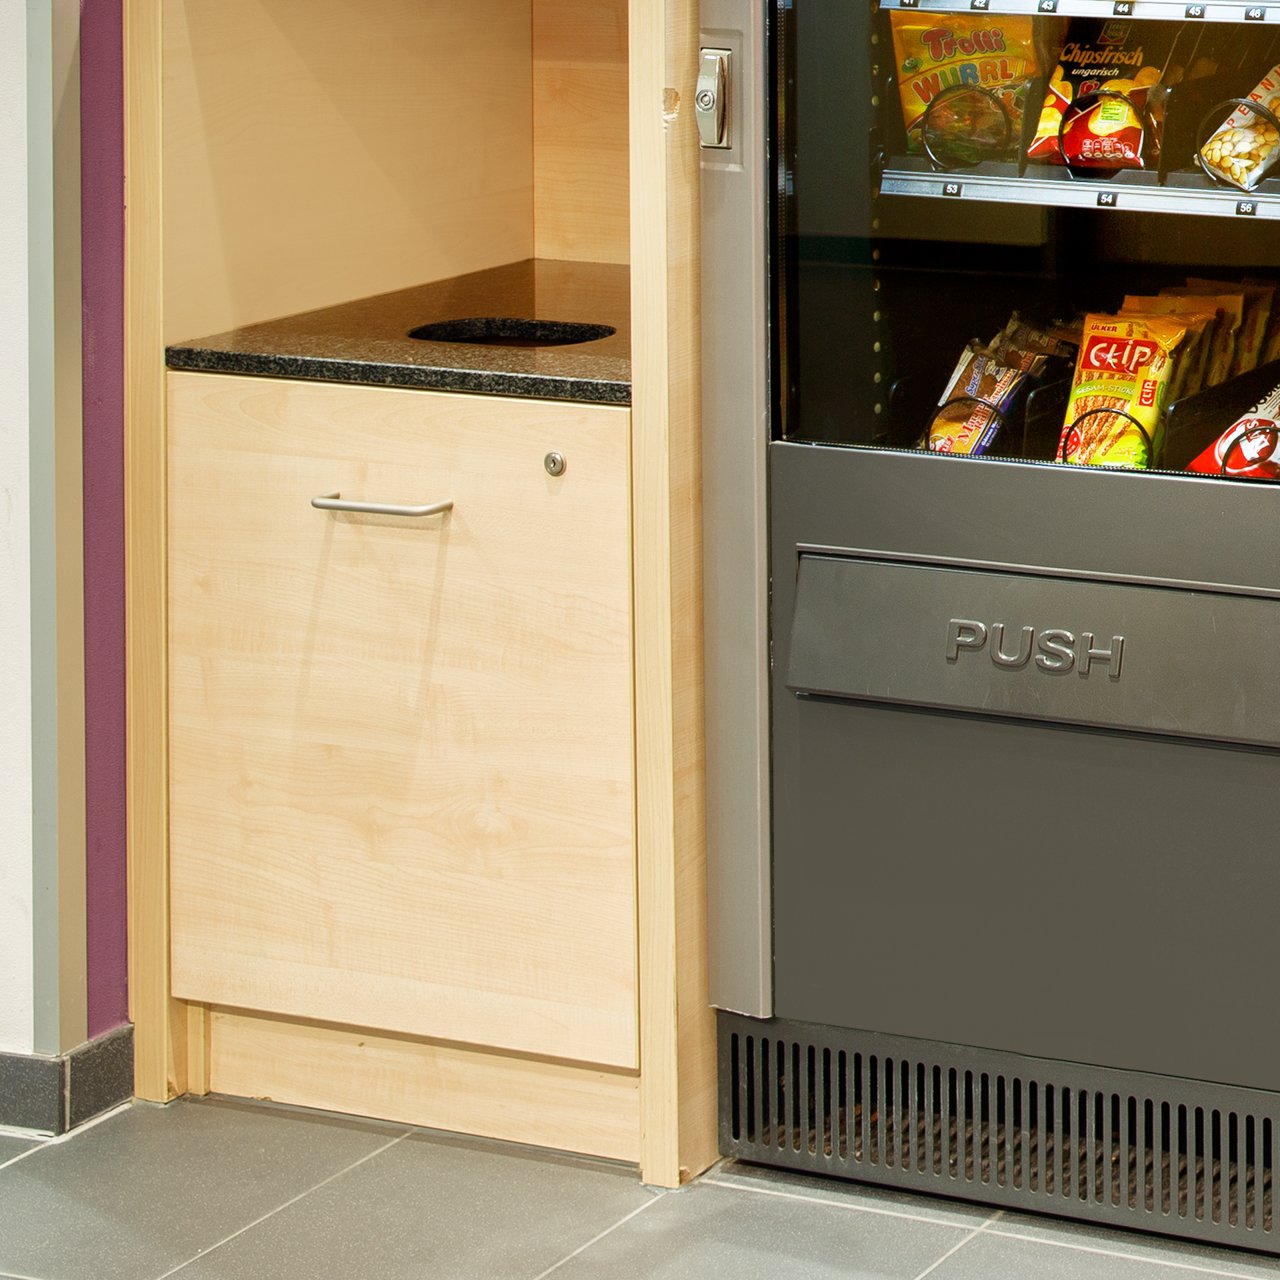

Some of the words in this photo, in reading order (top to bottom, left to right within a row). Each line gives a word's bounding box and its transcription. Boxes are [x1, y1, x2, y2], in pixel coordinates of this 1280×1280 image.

[1042, 0, 1053, 10] 43
[1116, 4, 1128, 12] 44
[1189, 6, 1201, 16] 45
[1248, 9, 1260, 18] 46
[922, 27, 1006, 62] Trolli
[1060, 42, 1144, 67] Chipsfrisch
[1072, 67, 1120, 77] ungarisch
[946, 184, 958, 194] 53
[1100, 194, 1113, 204] 54
[1240, 203, 1252, 212] 56
[1091, 323, 1118, 332] ÜLKER
[1090, 340, 1152, 371] CLIP
[1142, 380, 1156, 405] CLIP
[946, 618, 1125, 681] PUSH
